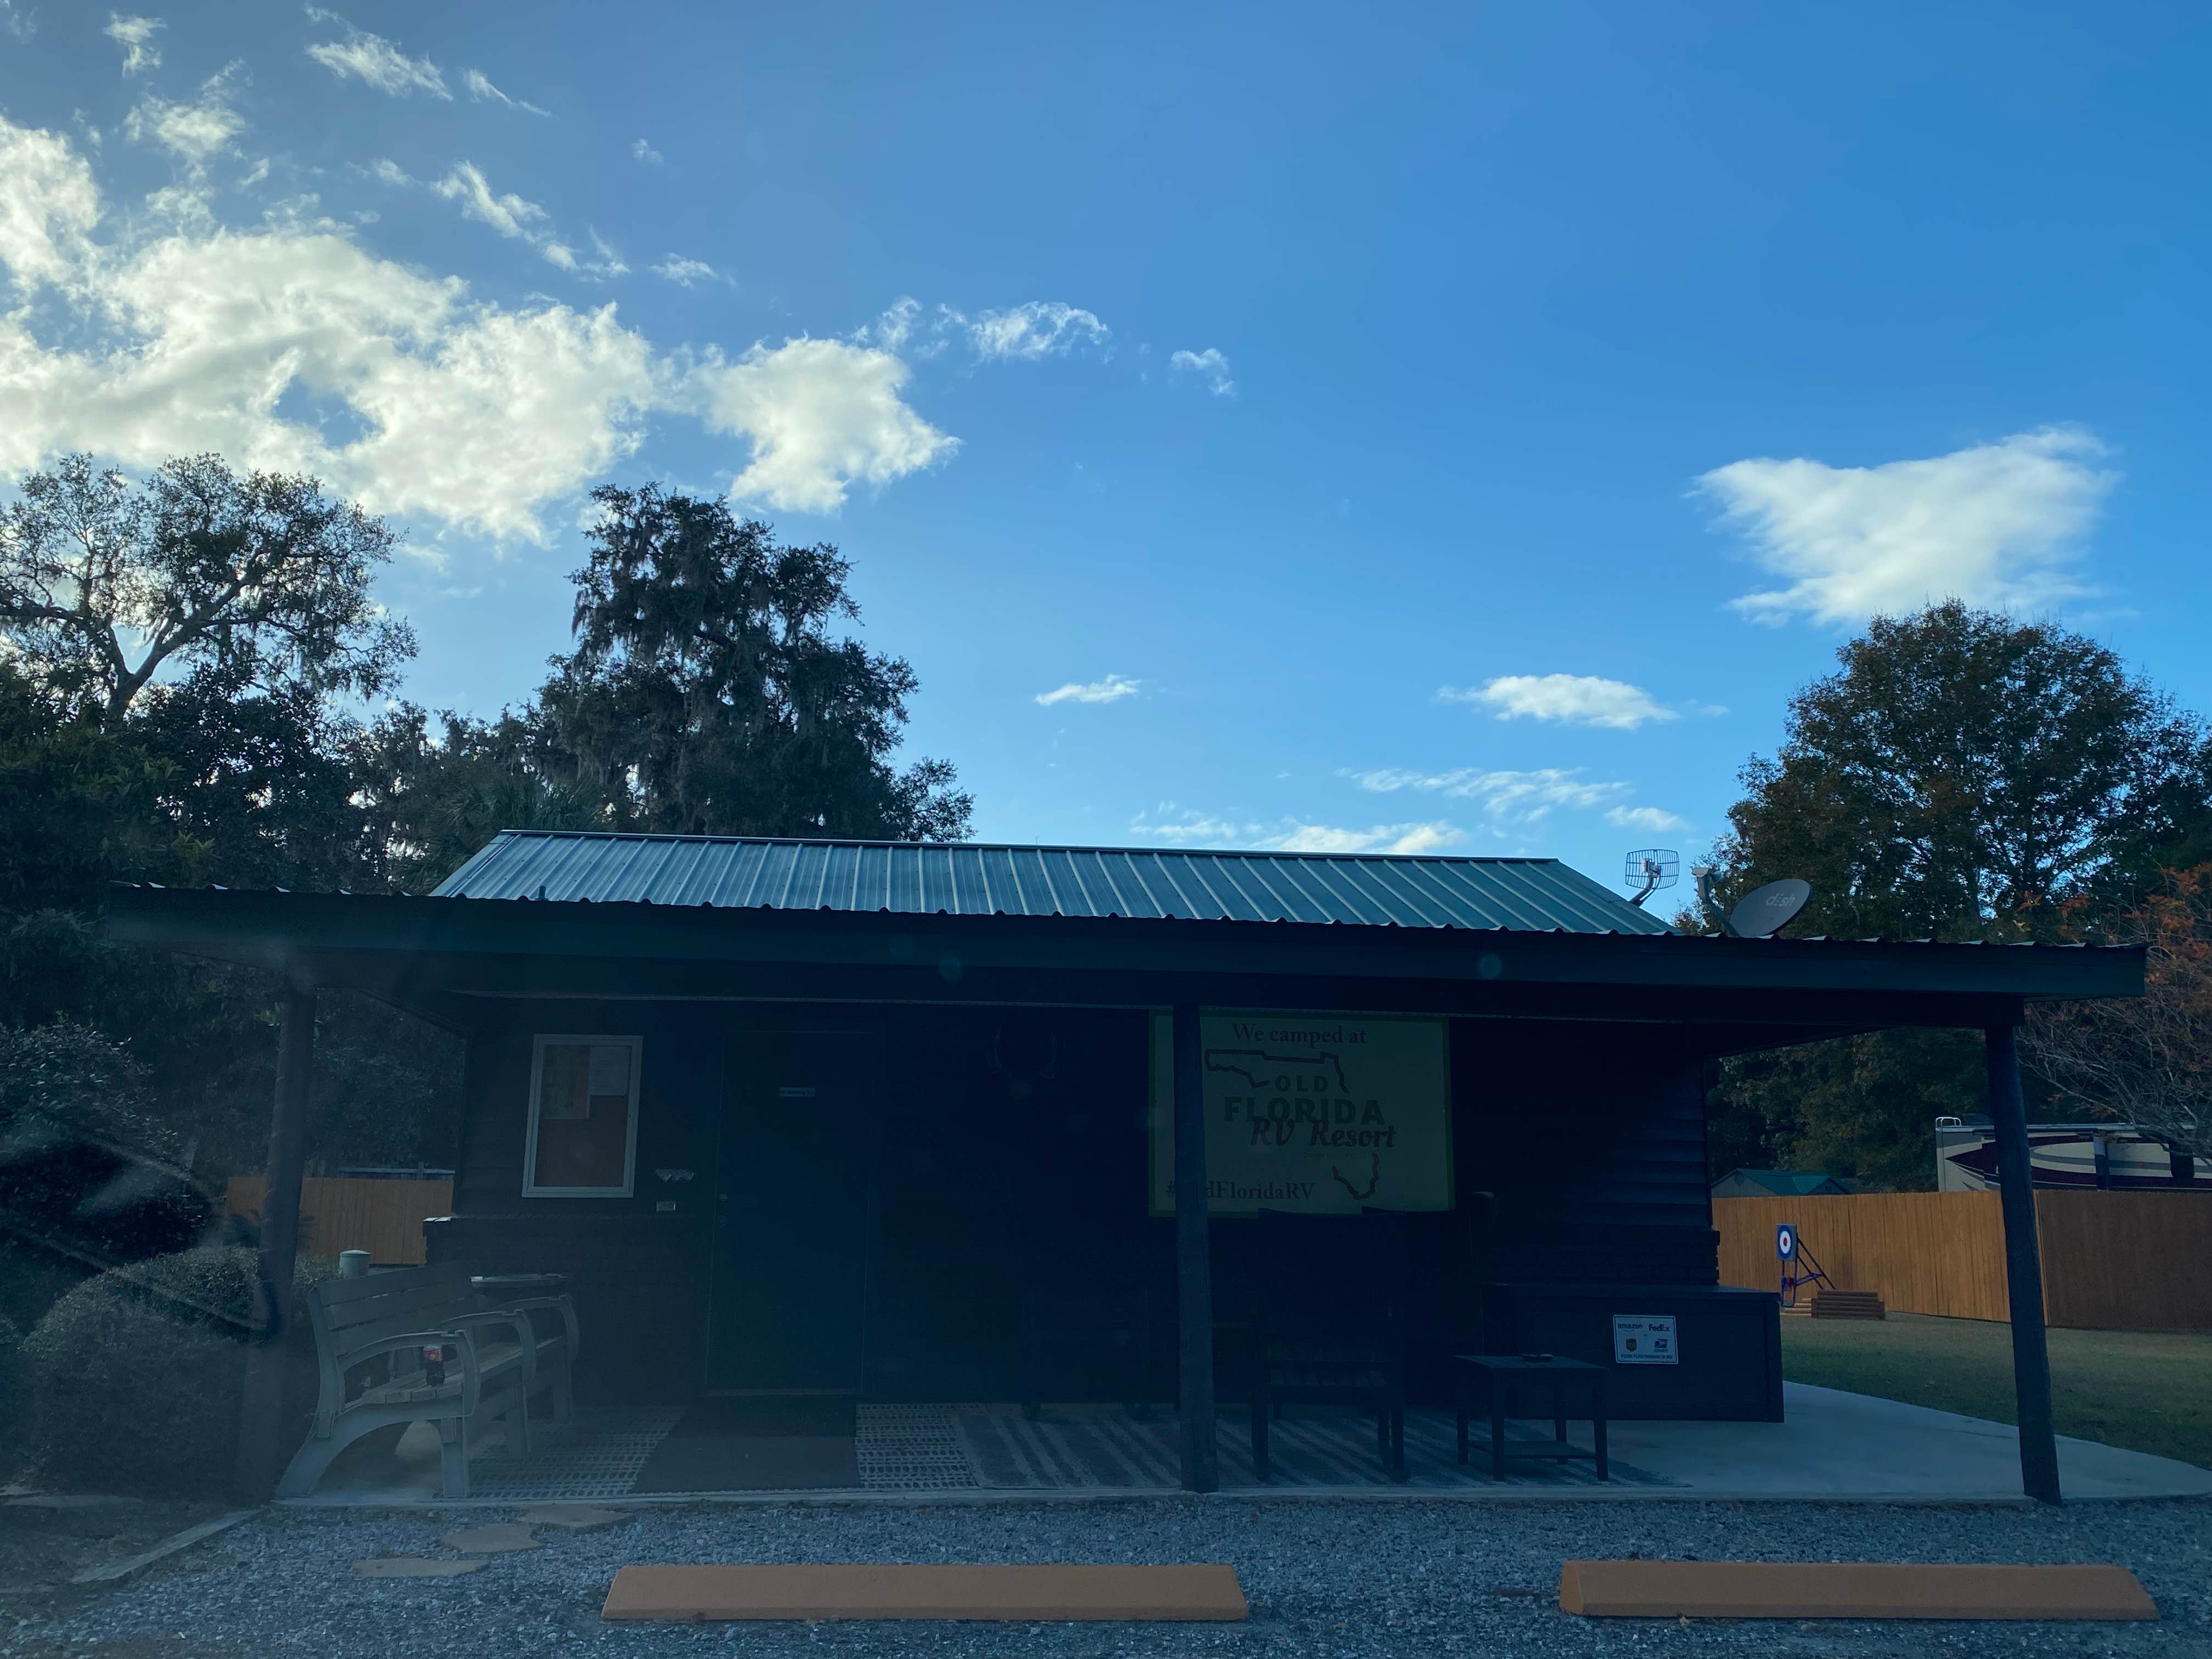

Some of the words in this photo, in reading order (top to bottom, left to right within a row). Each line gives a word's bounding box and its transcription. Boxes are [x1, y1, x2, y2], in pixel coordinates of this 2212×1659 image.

[1766, 893, 1796, 907] dish
[1233, 1023, 1264, 1041] We
[1268, 1025, 1343, 1048] camped
[1349, 1026, 1367, 1044] at
[1275, 1074, 1329, 1093] OLD
[1224, 1096, 1386, 1125] FLORIDA
[1250, 1115, 1294, 1146] RV
[1310, 1119, 1397, 1148] Resort
[1649, 1323, 1671, 1331] FedEx
